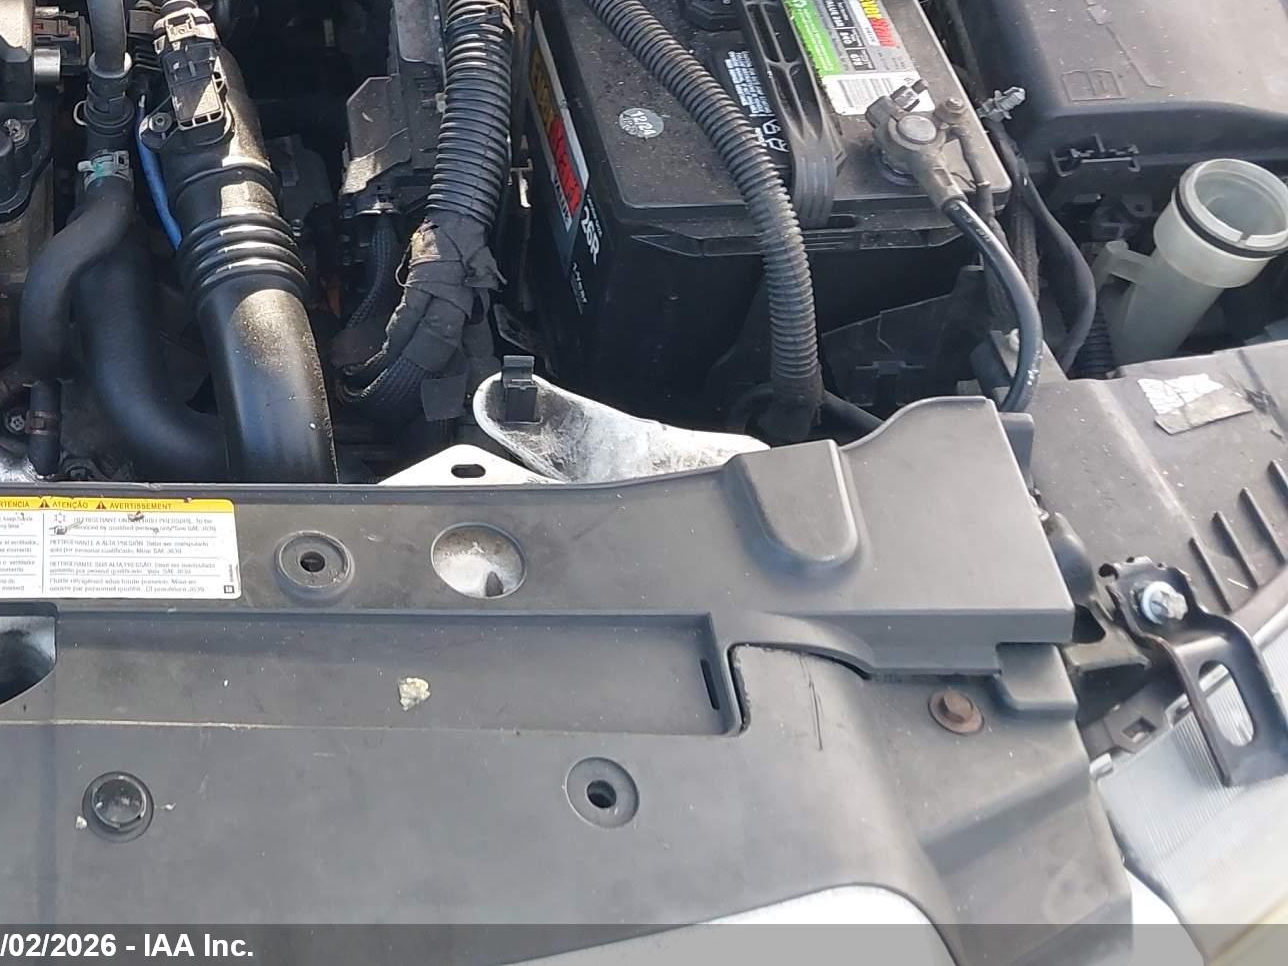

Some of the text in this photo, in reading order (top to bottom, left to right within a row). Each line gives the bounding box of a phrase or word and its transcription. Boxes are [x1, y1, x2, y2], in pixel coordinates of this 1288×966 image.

[629, 110, 657, 135] 12/24
[582, 205, 600, 265] 26R
[52, 500, 89, 509] ATENÇÃO
[109, 502, 172, 510] AVERTISSEMENT
